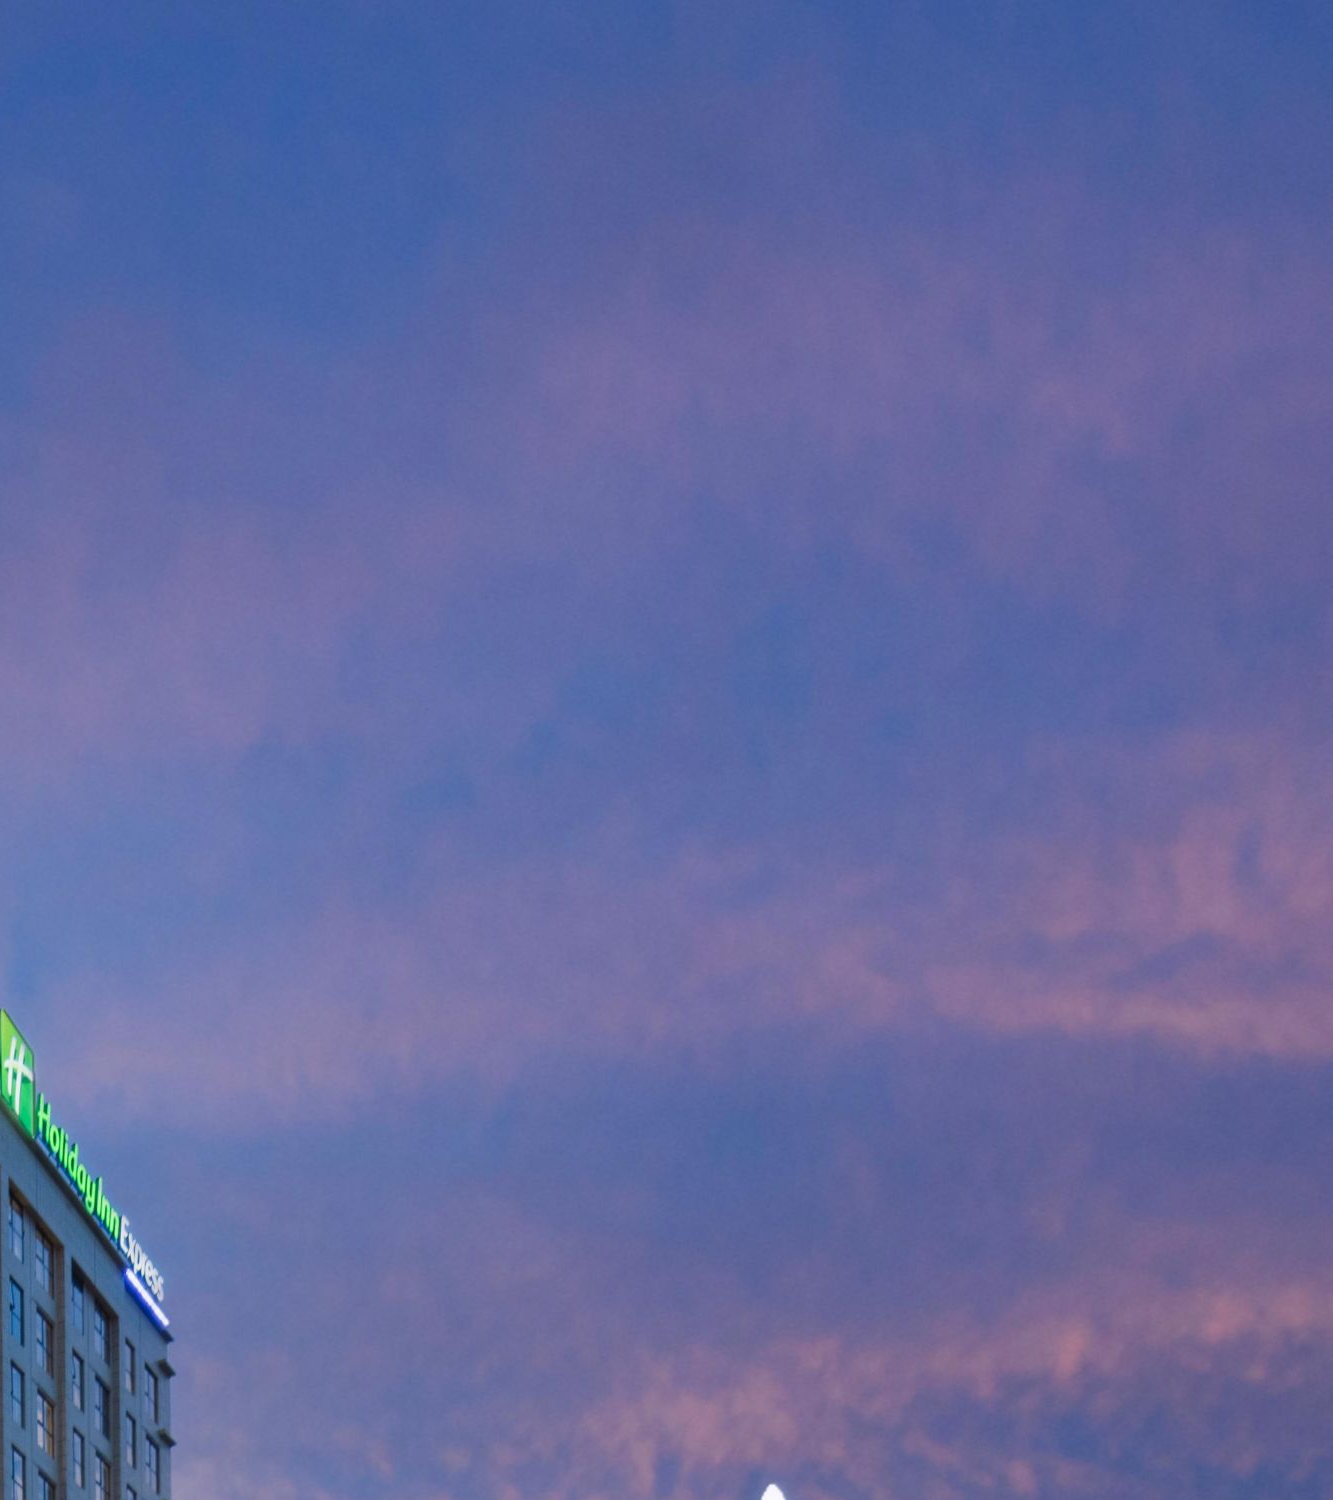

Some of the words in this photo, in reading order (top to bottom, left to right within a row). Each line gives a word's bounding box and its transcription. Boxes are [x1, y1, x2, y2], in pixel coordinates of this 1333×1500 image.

[37, 1092, 98, 1214] Holiday
[96, 1177, 120, 1240] Inn
[120, 1214, 165, 1302] Express
